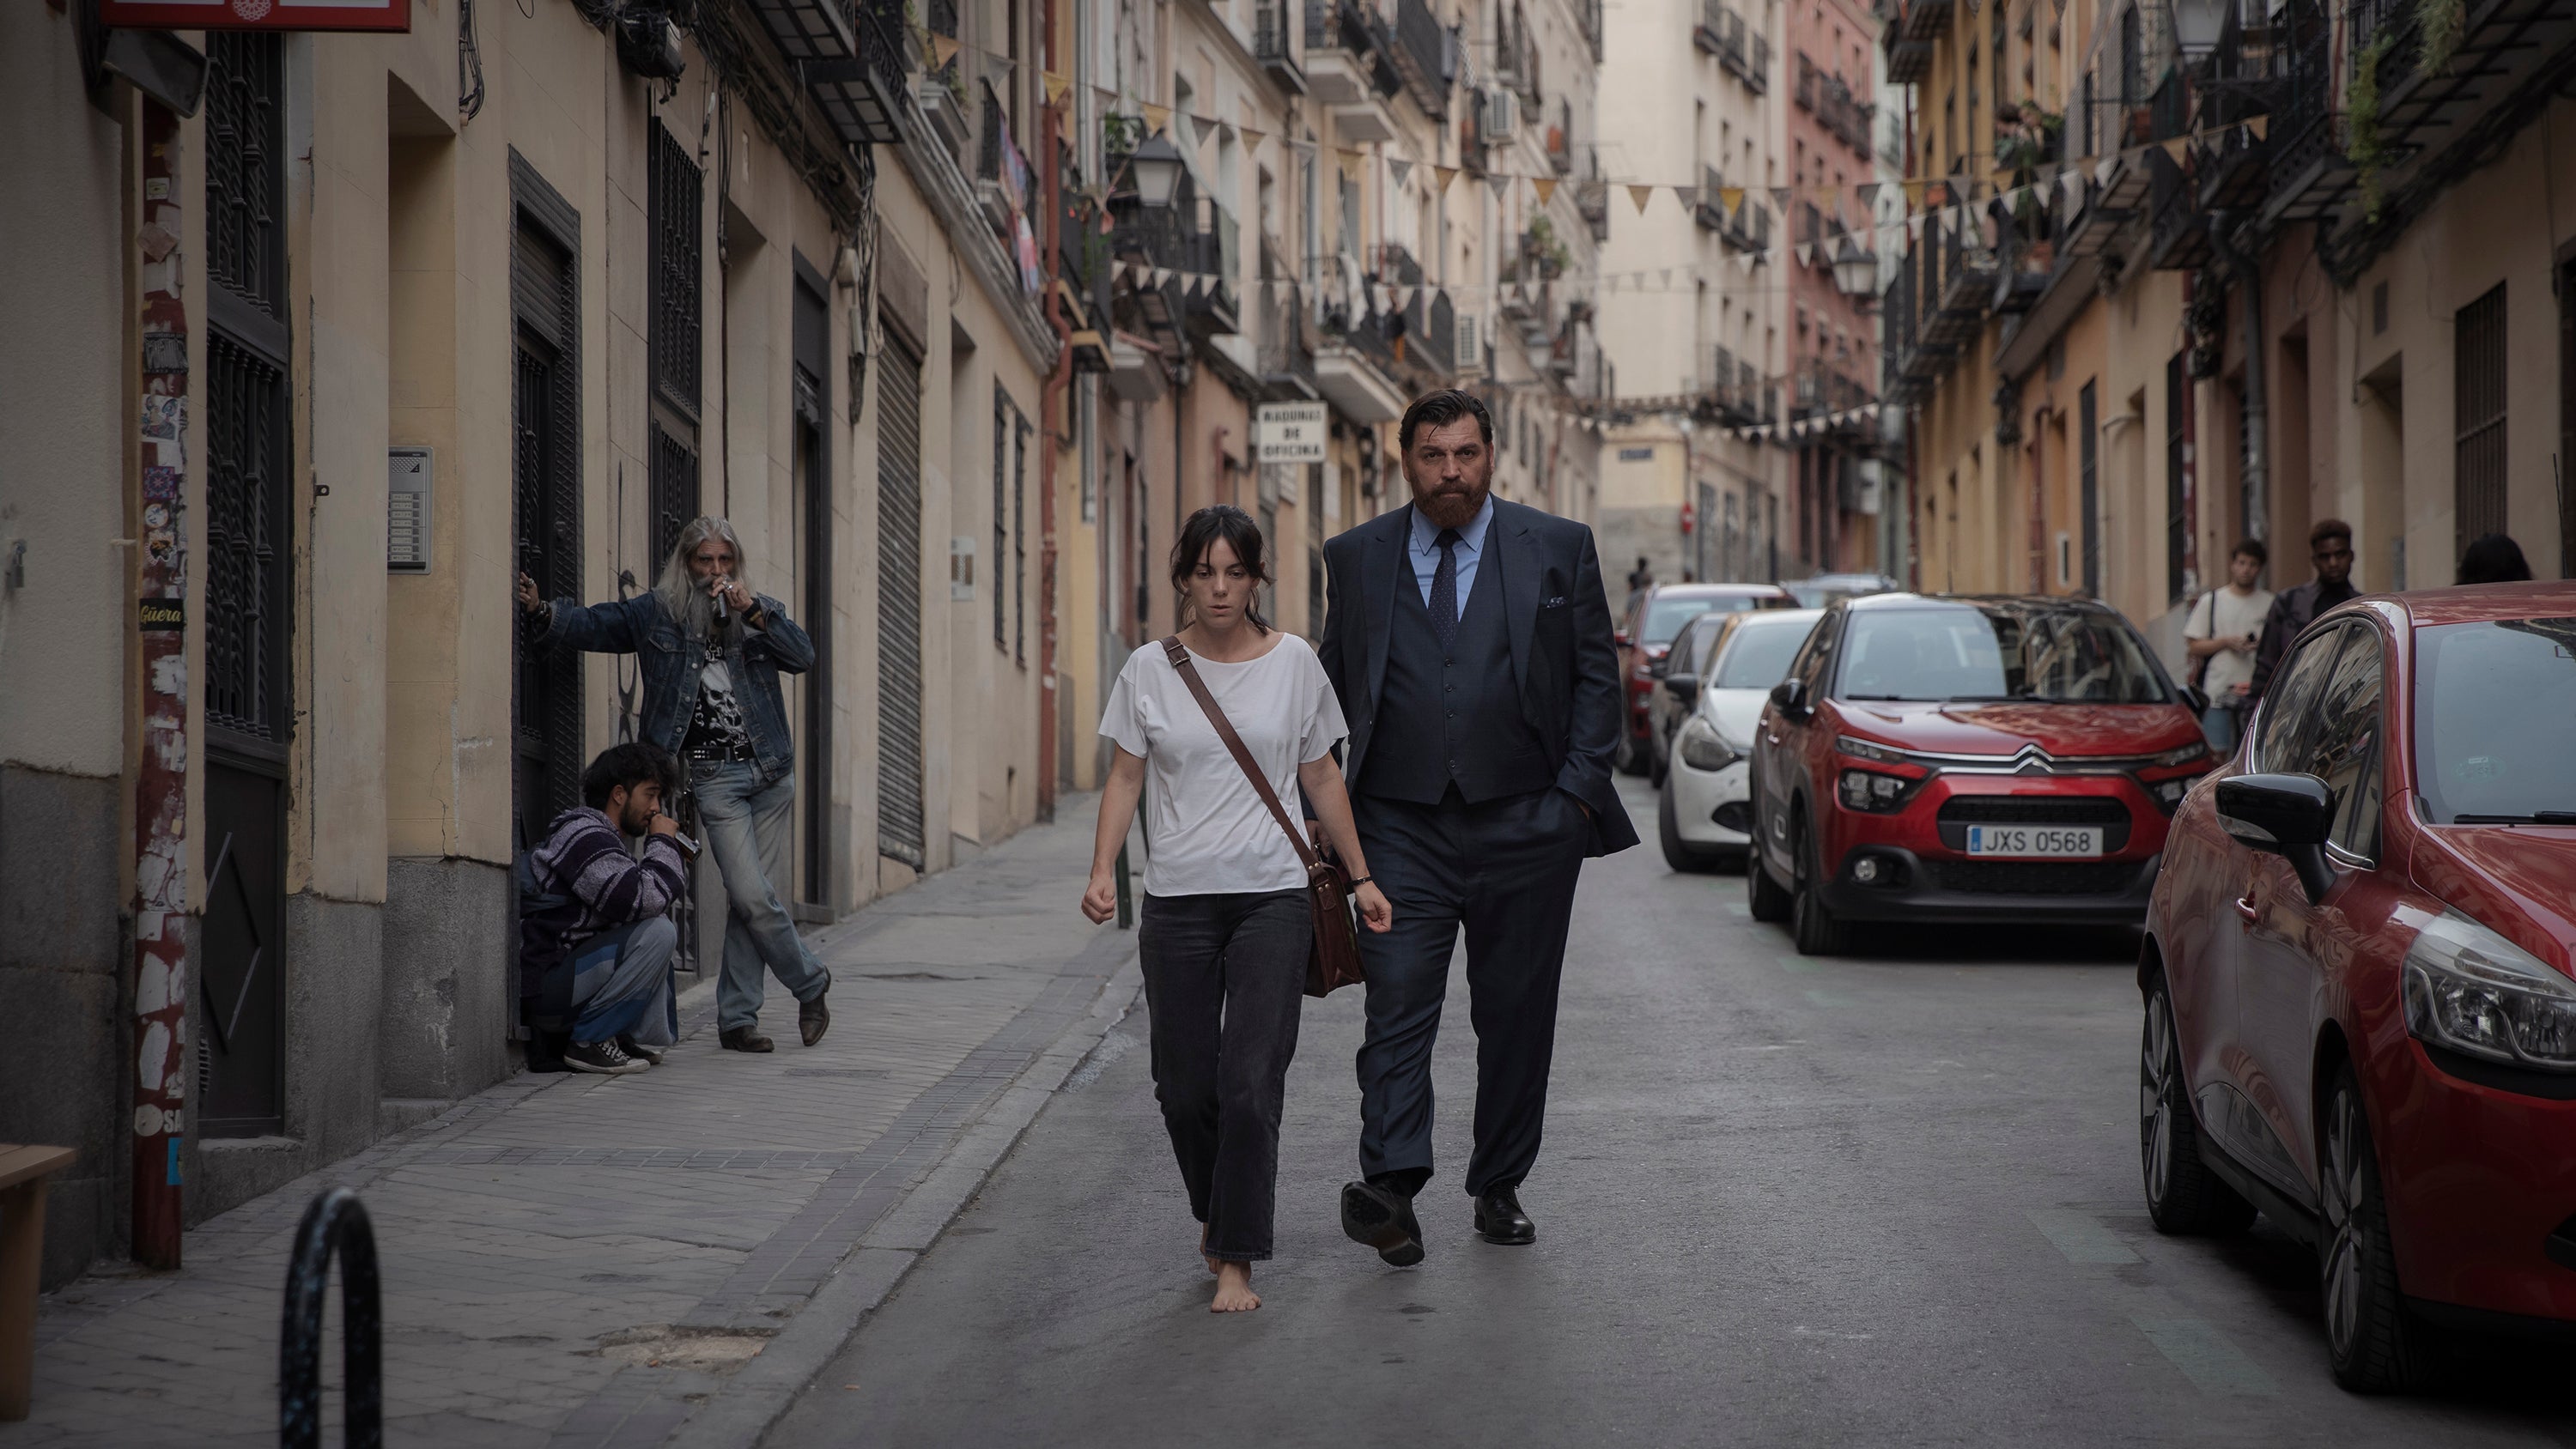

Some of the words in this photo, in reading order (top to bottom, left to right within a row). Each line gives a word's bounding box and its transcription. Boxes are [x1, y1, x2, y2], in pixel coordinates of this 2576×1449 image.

[1284, 427, 1301, 440] DE
[1264, 445, 1320, 457] OFICINA
[1985, 830, 2026, 852] JXS
[2035, 831, 2091, 852] 0568
